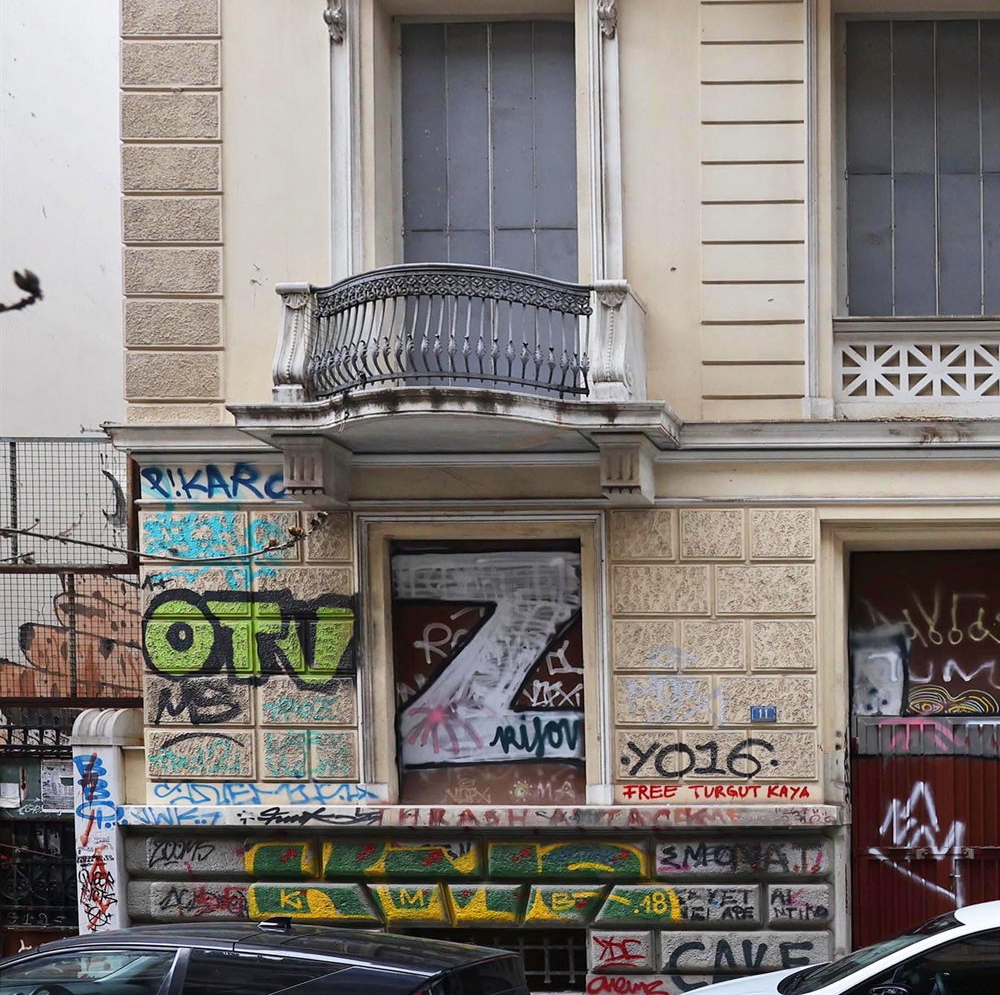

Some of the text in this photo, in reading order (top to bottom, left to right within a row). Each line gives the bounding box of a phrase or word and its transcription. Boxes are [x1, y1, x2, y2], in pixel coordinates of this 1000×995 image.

[758, 708, 768, 720] 11
[622, 784, 810, 800] FREE TURGUT KAYA
